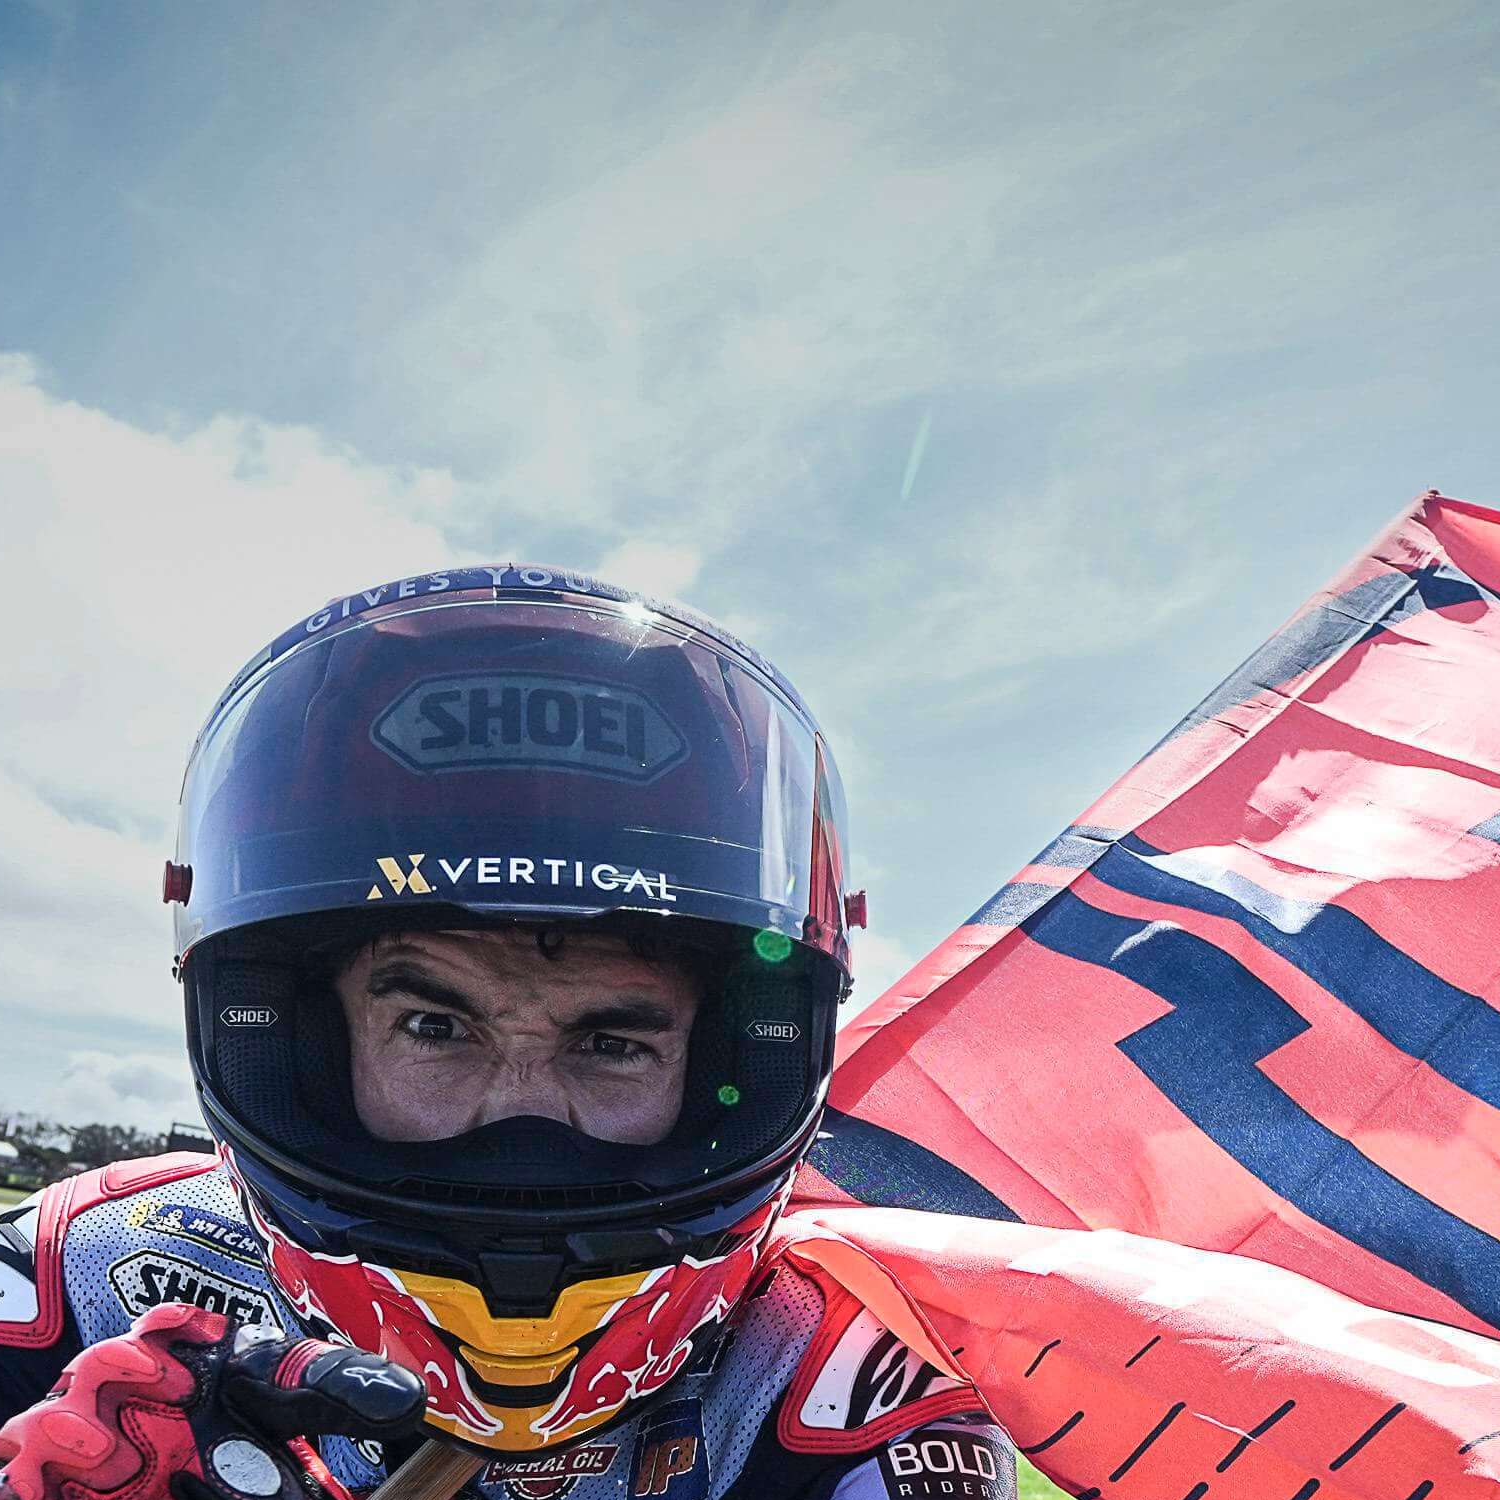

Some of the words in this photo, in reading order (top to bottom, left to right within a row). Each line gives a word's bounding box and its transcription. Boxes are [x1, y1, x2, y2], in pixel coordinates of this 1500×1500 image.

[304, 572, 451, 635] GIVES
[417, 684, 649, 766] SHOEI
[438, 855, 679, 903] VERTICAL
[228, 1006, 272, 1026] SHOEI
[753, 1020, 794, 1041] SHOEI
[572, 1451, 604, 1470] OIL
[634, 1434, 698, 1497] IP
[887, 1439, 998, 1482] BOLD
